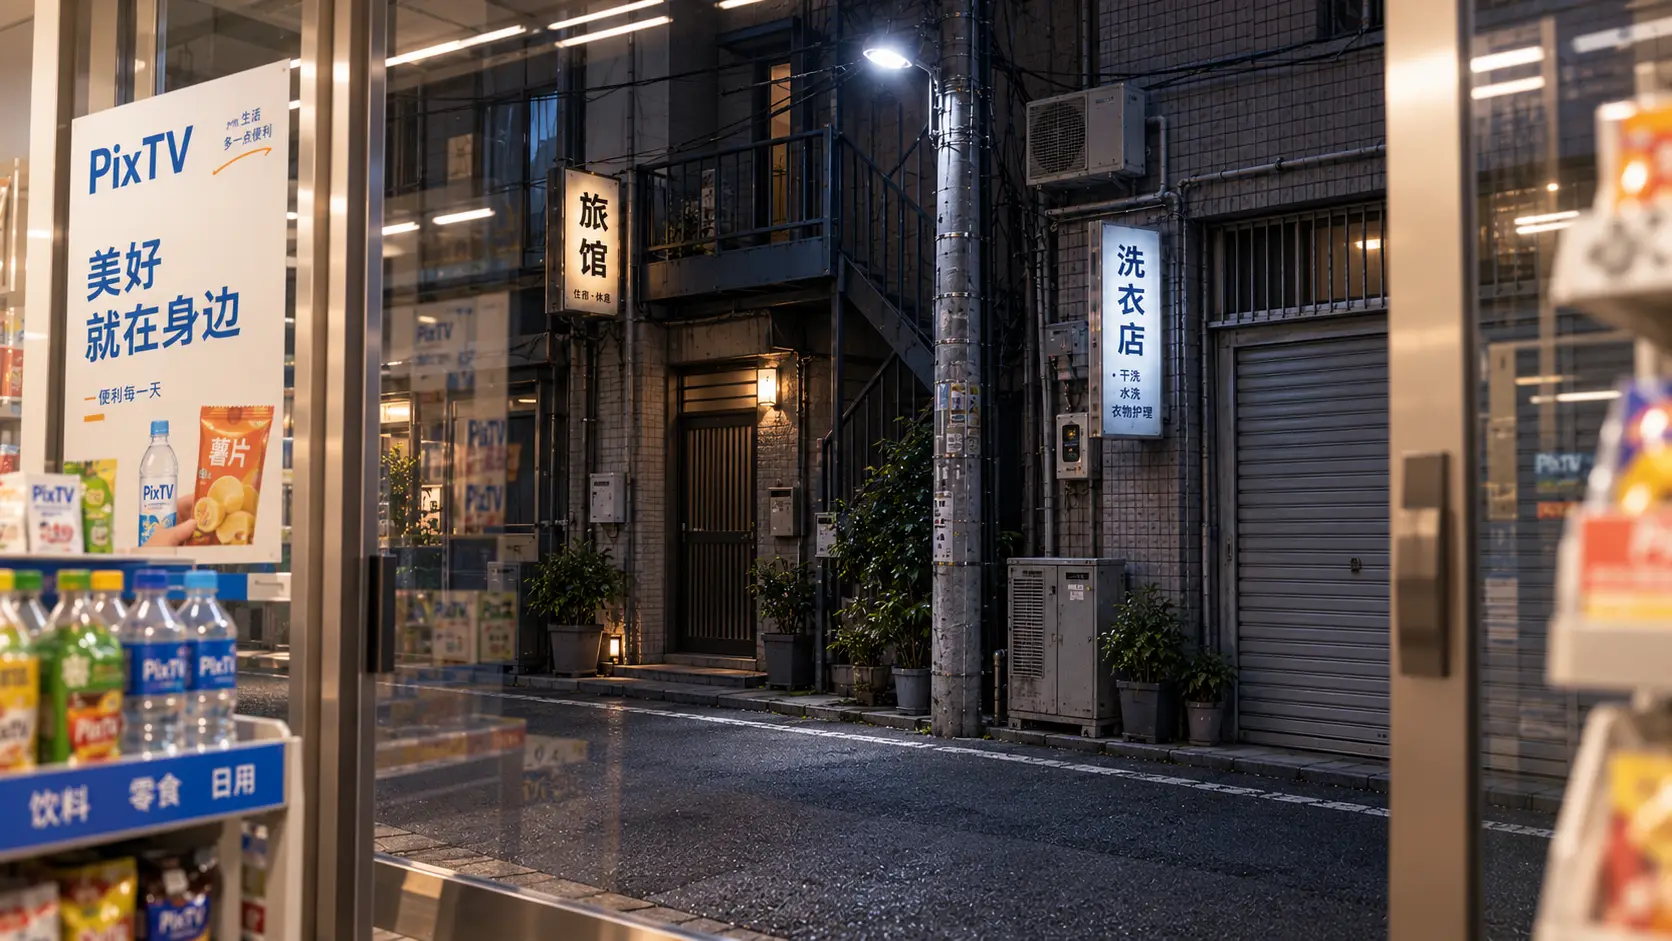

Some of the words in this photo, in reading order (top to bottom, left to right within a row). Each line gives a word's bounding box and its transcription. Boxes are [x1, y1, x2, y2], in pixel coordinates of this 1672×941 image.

[241, 107, 261, 126] 生活
[224, 123, 272, 151] 多一点便利
[89, 125, 194, 195] PixTV
[579, 192, 609, 279] 旅馆
[87, 238, 162, 301] 美好
[1117, 244, 1146, 356] 洗衣店
[85, 286, 242, 363] 就在身边
[99, 382, 162, 405] 便利每一天
[1120, 386, 1141, 400] 水洗
[1112, 405, 1153, 419] 衣物护理
[209, 437, 250, 468] 薯片
[32, 484, 75, 504] PixTV
[143, 484, 174, 500] PixTV
[30, 785, 91, 829] 饮料
[129, 772, 182, 812] 零食
[211, 763, 256, 799] 日用
